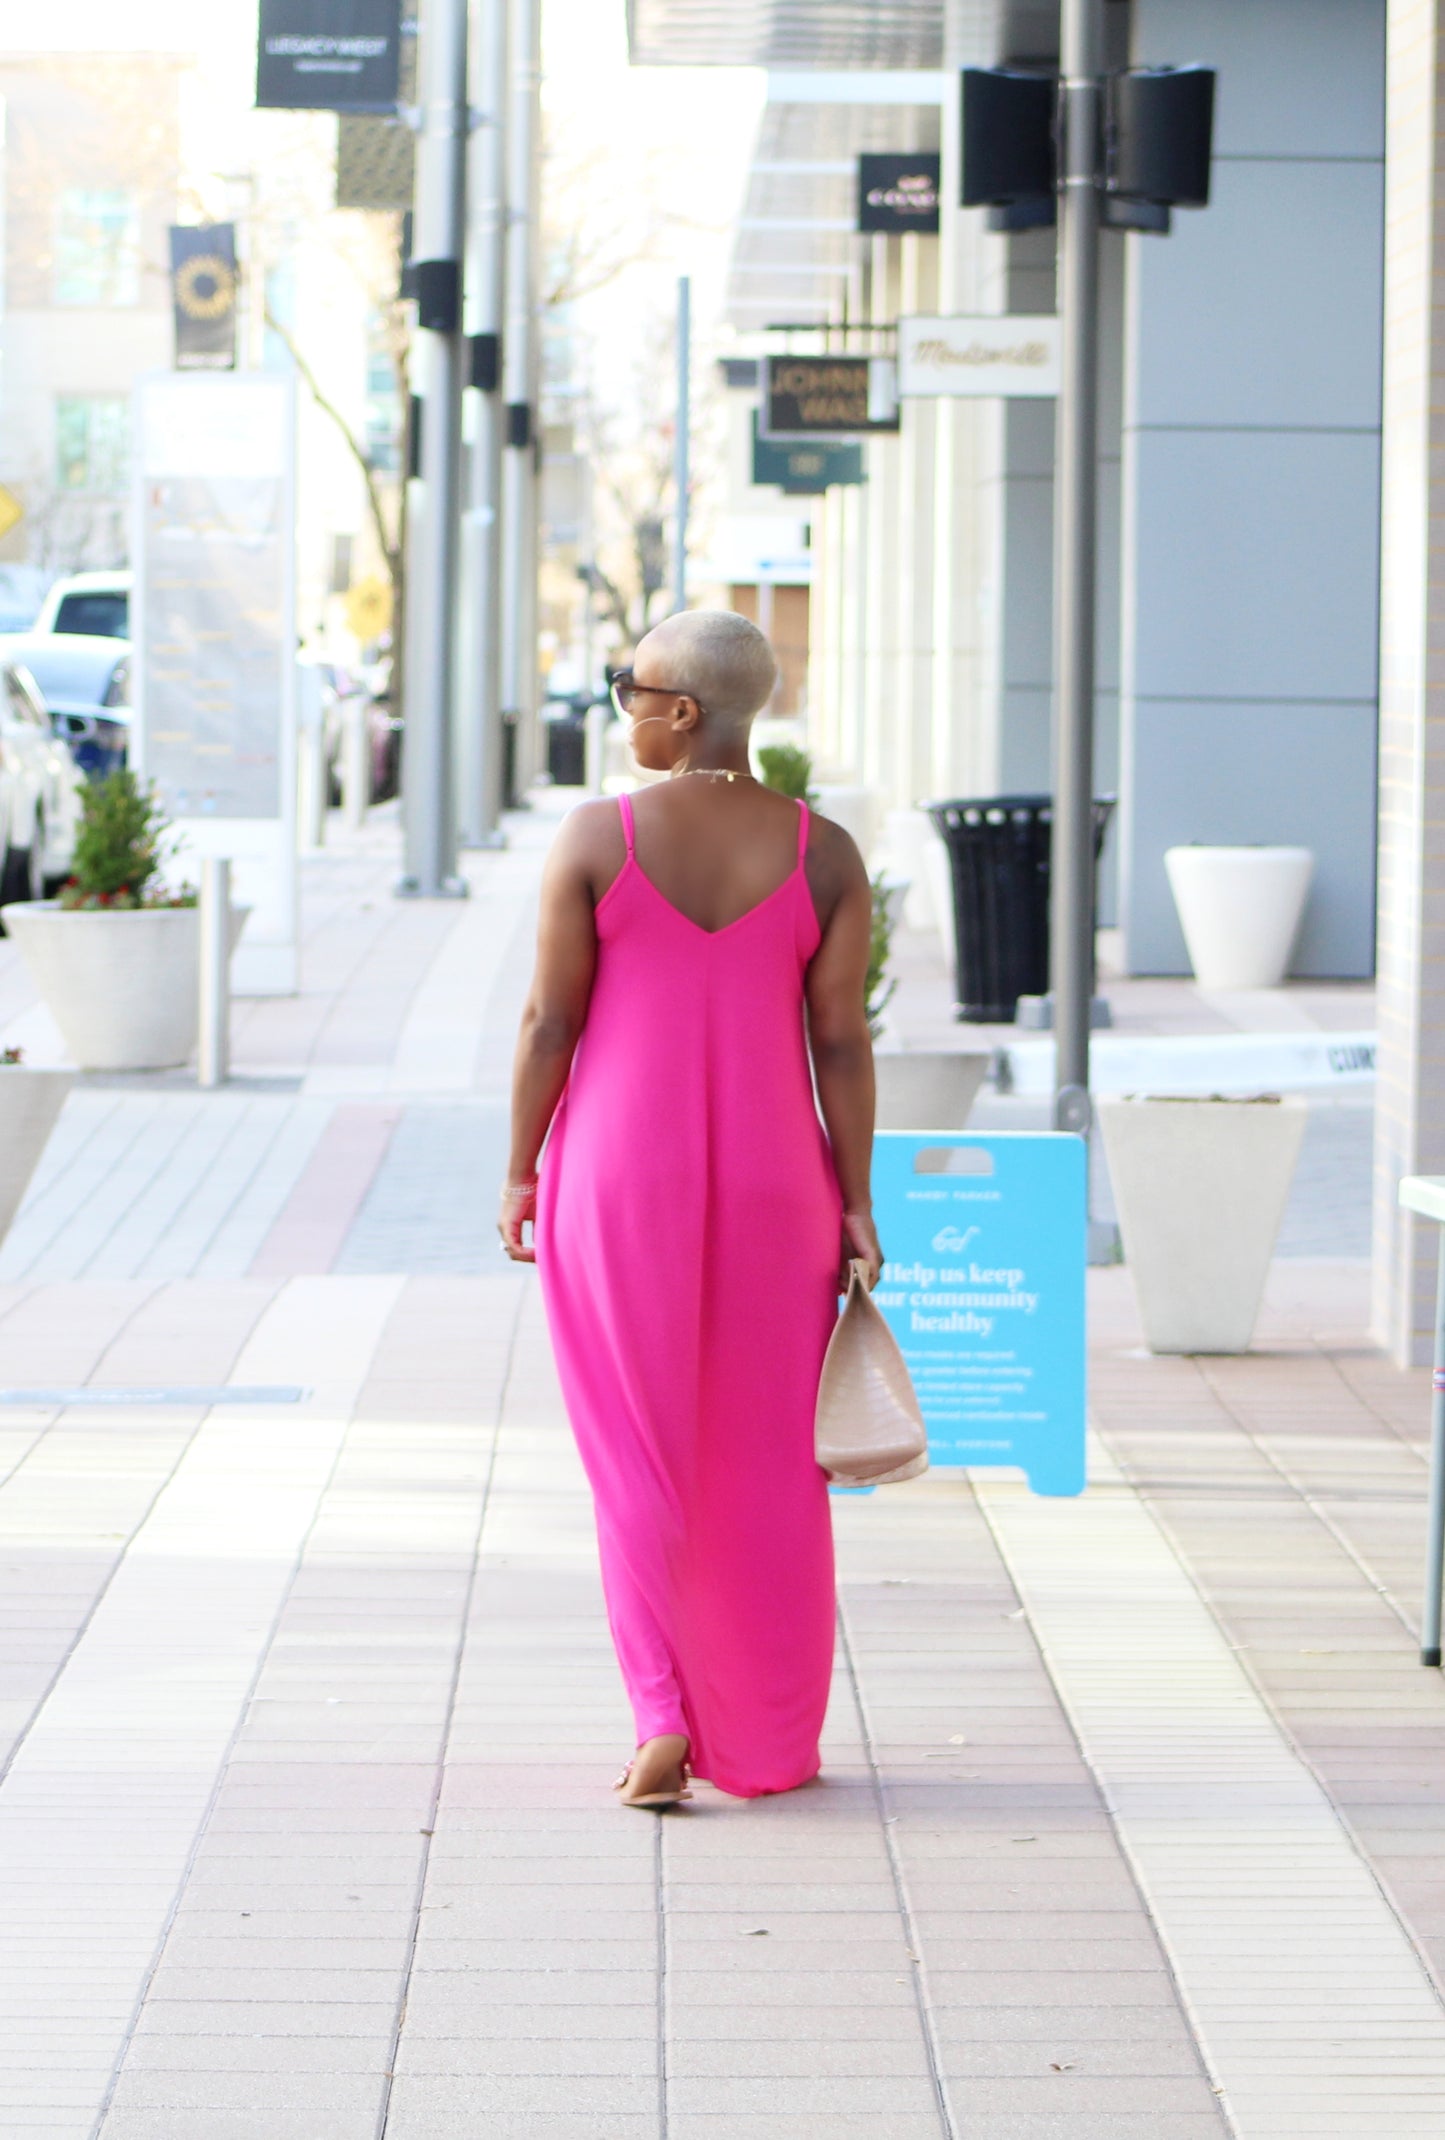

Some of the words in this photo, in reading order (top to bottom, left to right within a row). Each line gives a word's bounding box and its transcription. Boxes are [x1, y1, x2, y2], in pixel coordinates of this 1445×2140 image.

[866, 188, 938, 208] COAC
[771, 366, 868, 396] JOHNN
[1327, 1044, 1375, 1074] CUR
[882, 1261, 936, 1289] Help
[940, 1266, 965, 1283] us
[969, 1262, 1025, 1289] keep
[909, 1287, 1038, 1314] community
[911, 1311, 994, 1337] healthy
